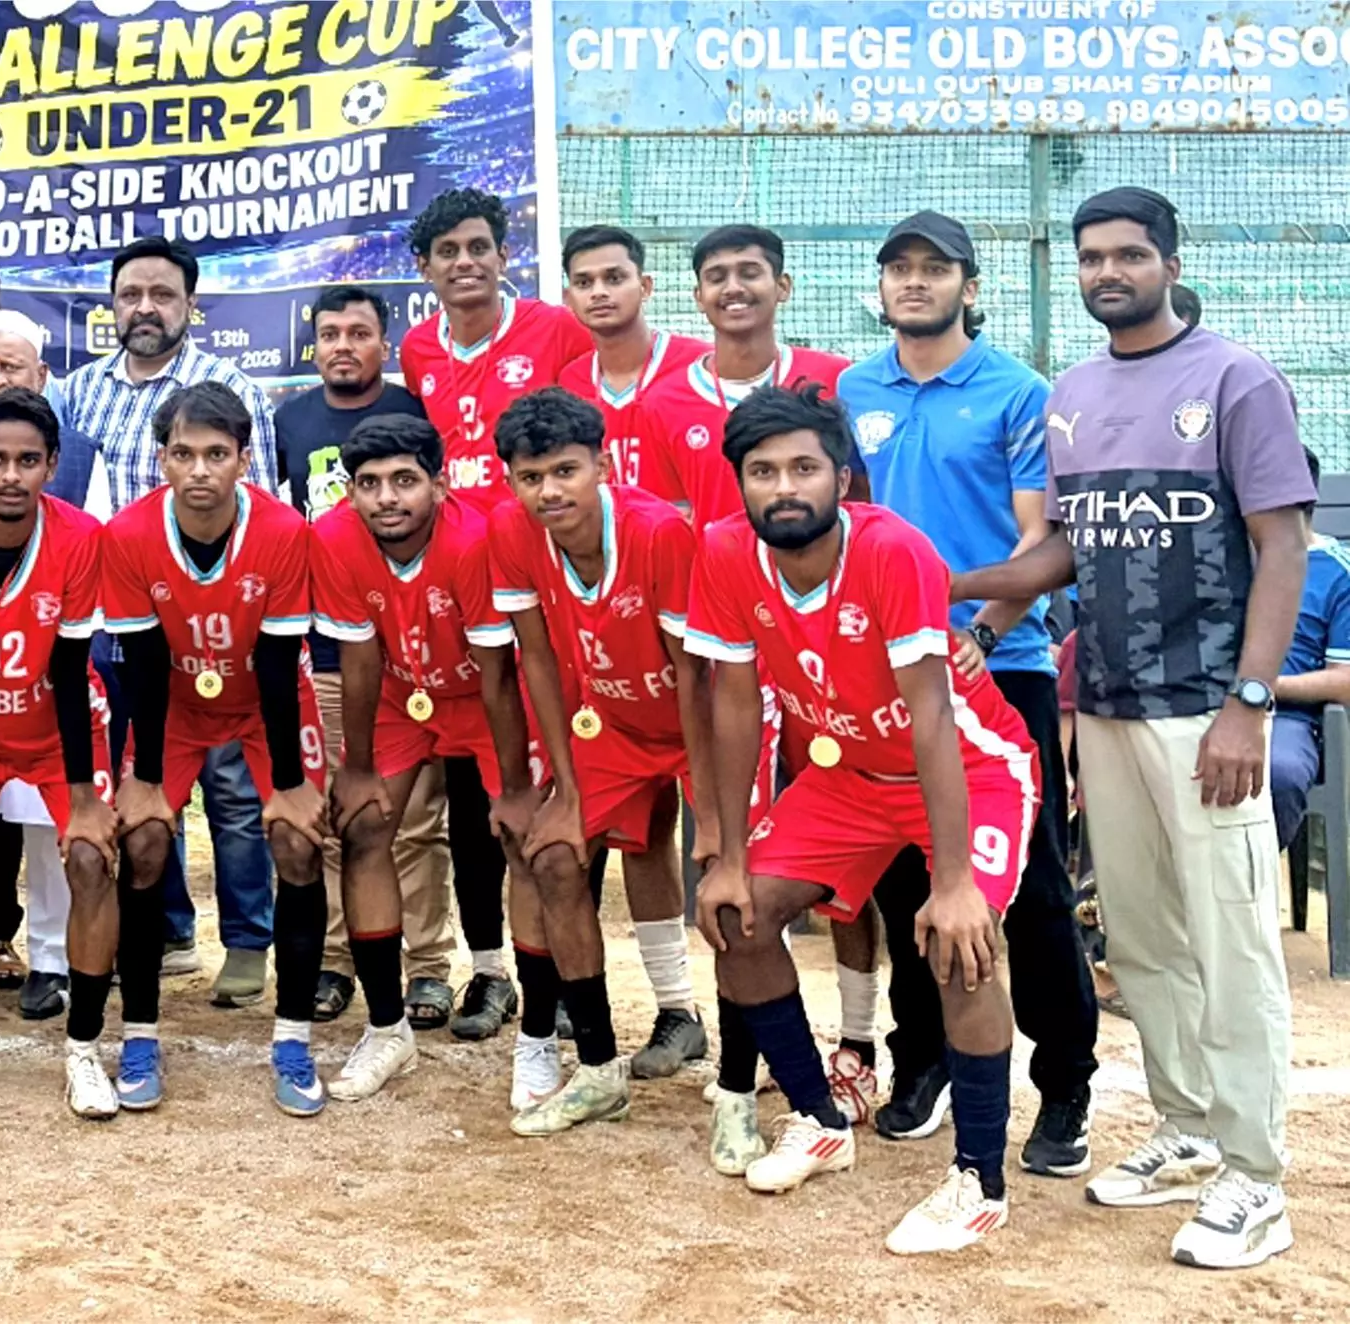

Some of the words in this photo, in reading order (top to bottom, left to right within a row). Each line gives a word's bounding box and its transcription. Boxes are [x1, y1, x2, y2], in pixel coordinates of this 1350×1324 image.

[927, 1, 1111, 19] CONSTIUENT
[1119, 1, 1157, 19] OF
[318, 0, 459, 66] CUP
[566, 27, 681, 70] CITY
[696, 26, 912, 70] COLLEGE
[927, 26, 1027, 69] OLD
[1043, 25, 1180, 69] BOYS
[1198, 25, 1350, 69] ASSO
[851, 75, 926, 98] QULI
[934, 75, 1044, 98] QUTUB
[1052, 74, 1133, 94] SHAH
[1141, 73, 1272, 94] STADIUM
[26, 85, 312, 157] UNDER-21
[727, 101, 809, 125] Contact
[1106, 98, 1349, 125] 9849045005
[179, 134, 387, 201] KNOCKOUT
[157, 173, 414, 242] TOURNAMENT
[211, 330, 249, 347] 13th
[241, 349, 281, 369] 2026
[1067, 528, 1173, 548] IRWAYS
[186, 612, 234, 650] 19
[643, 664, 677, 698] FC
[872, 697, 912, 738] FC
[971, 825, 1009, 876] 9
